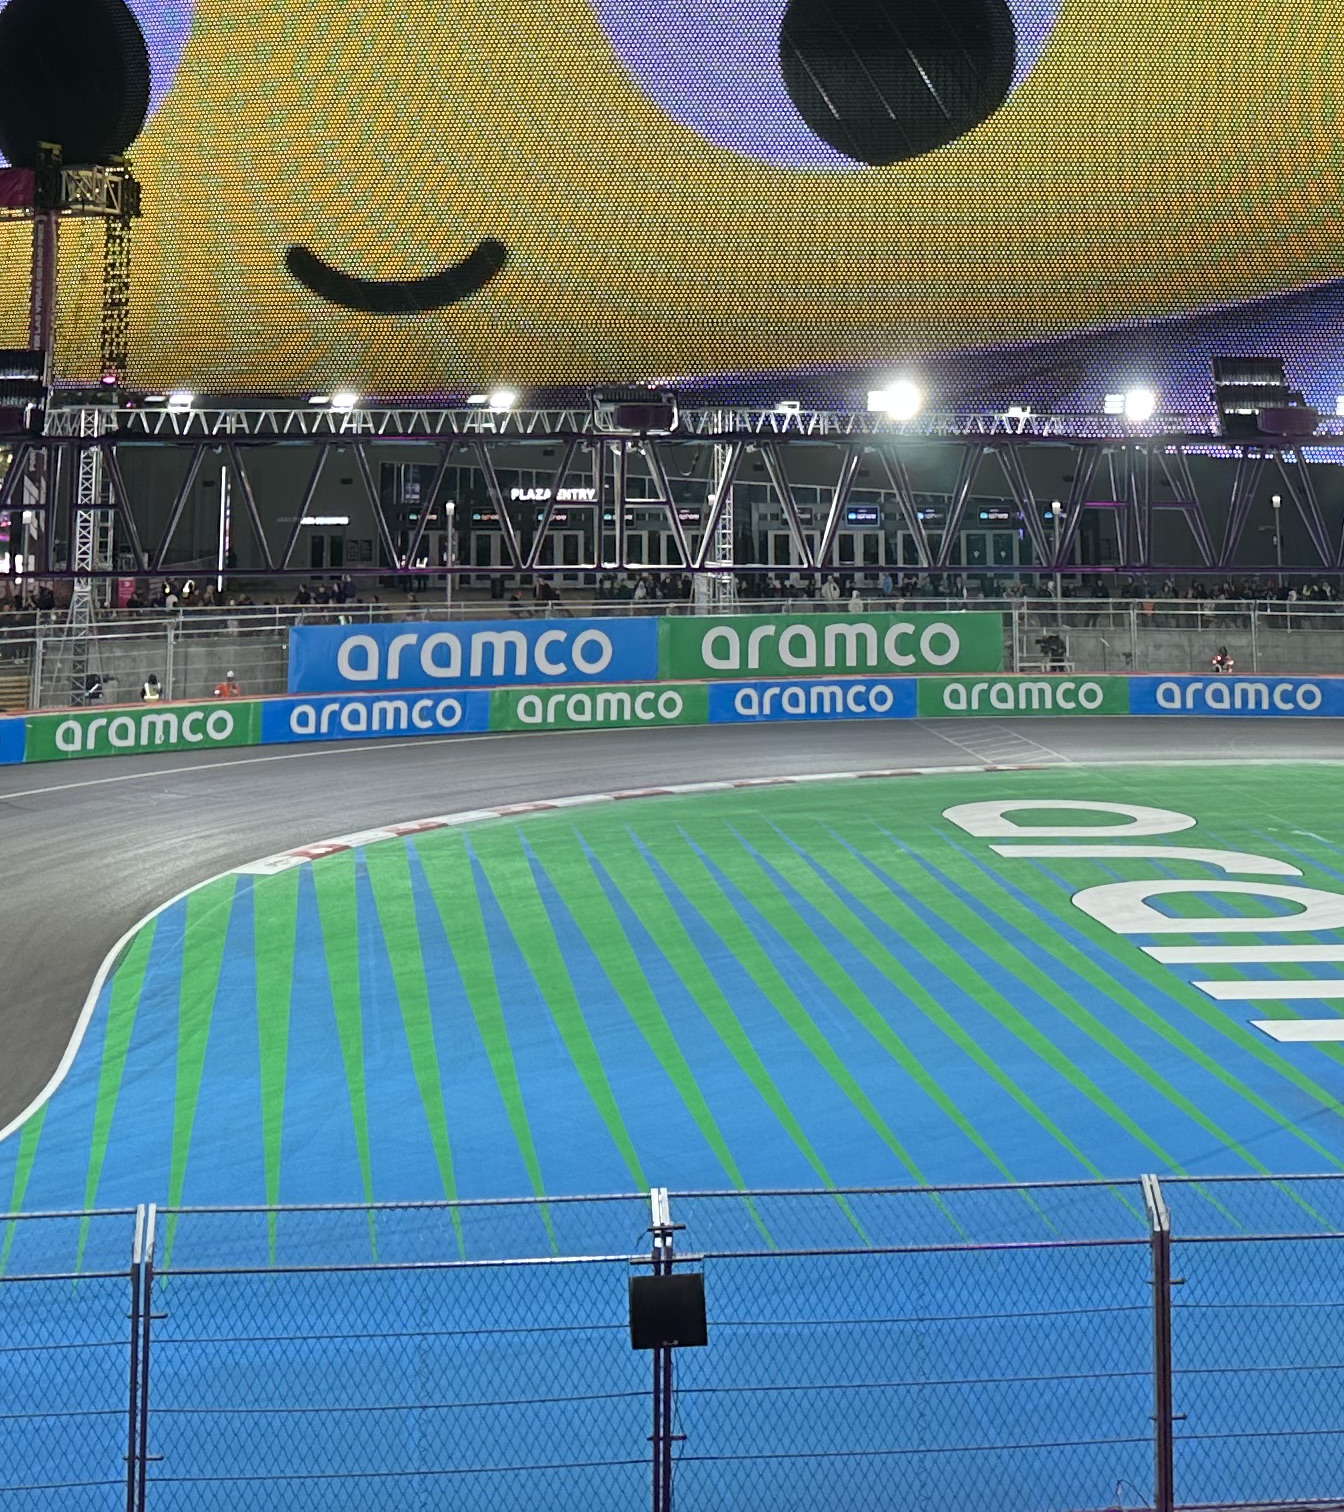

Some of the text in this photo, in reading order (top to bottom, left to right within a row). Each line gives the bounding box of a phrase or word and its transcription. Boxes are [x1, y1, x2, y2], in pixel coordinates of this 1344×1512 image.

[511, 488, 552, 501] PLAZA
[338, 630, 613, 680] aramco
[702, 623, 960, 669] aramco
[517, 691, 683, 724] aramco
[734, 686, 893, 716] aramco
[943, 682, 1104, 710] aramco
[1157, 682, 1322, 710] aramco
[56, 710, 234, 752] aramco
[290, 698, 462, 734] aramco
